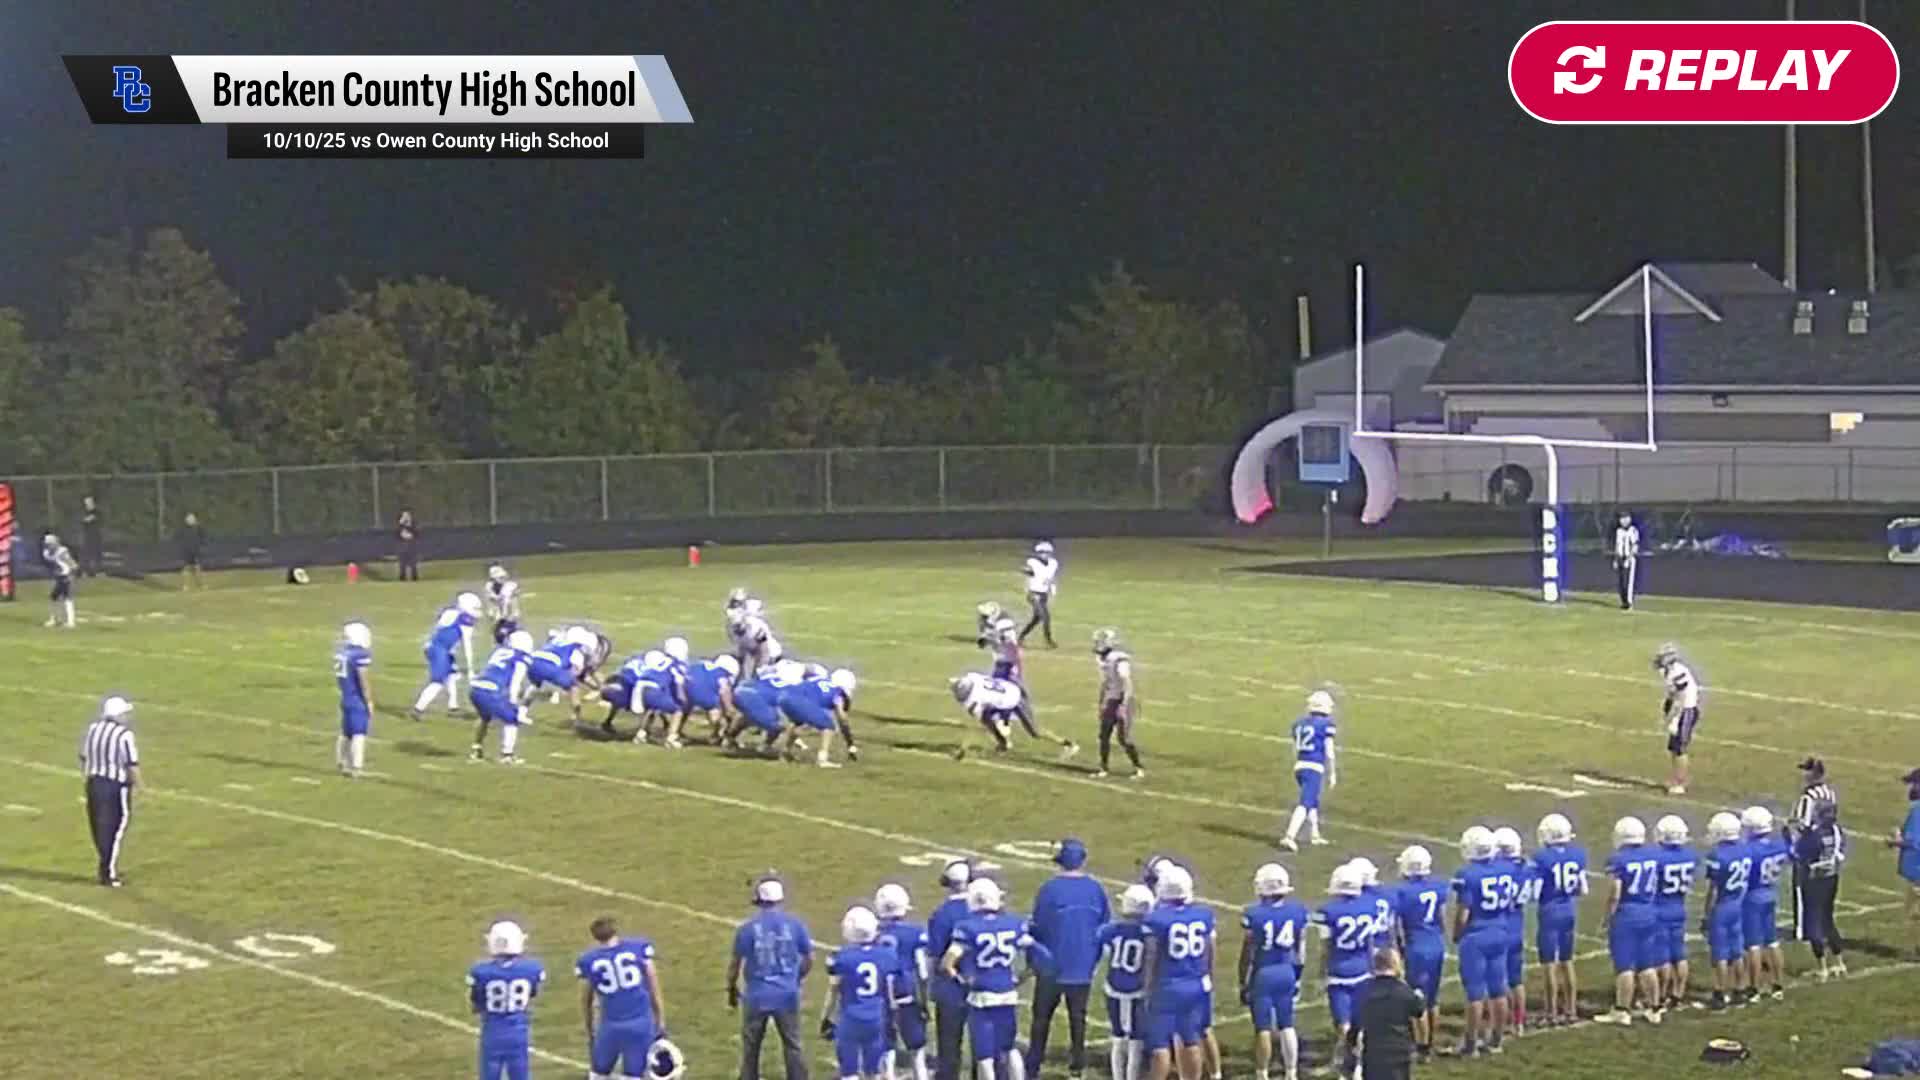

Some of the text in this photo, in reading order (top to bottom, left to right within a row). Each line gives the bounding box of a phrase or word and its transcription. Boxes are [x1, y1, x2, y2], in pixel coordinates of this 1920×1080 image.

[1294, 724, 1316, 752] 12
[1481, 875, 1515, 910] 53
[1552, 861, 1580, 894] 16
[1626, 861, 1659, 894] 77
[1663, 863, 1696, 895] 55
[1419, 891, 1438, 923] 7
[1168, 921, 1206, 960] 66
[1261, 919, 1295, 951] 14
[1337, 915, 1375, 949] 22
[975, 931, 1018, 968] 25
[1111, 935, 1143, 973] 10
[592, 952, 642, 995] 36
[856, 961, 879, 997] 3
[485, 980, 529, 1013] 88
